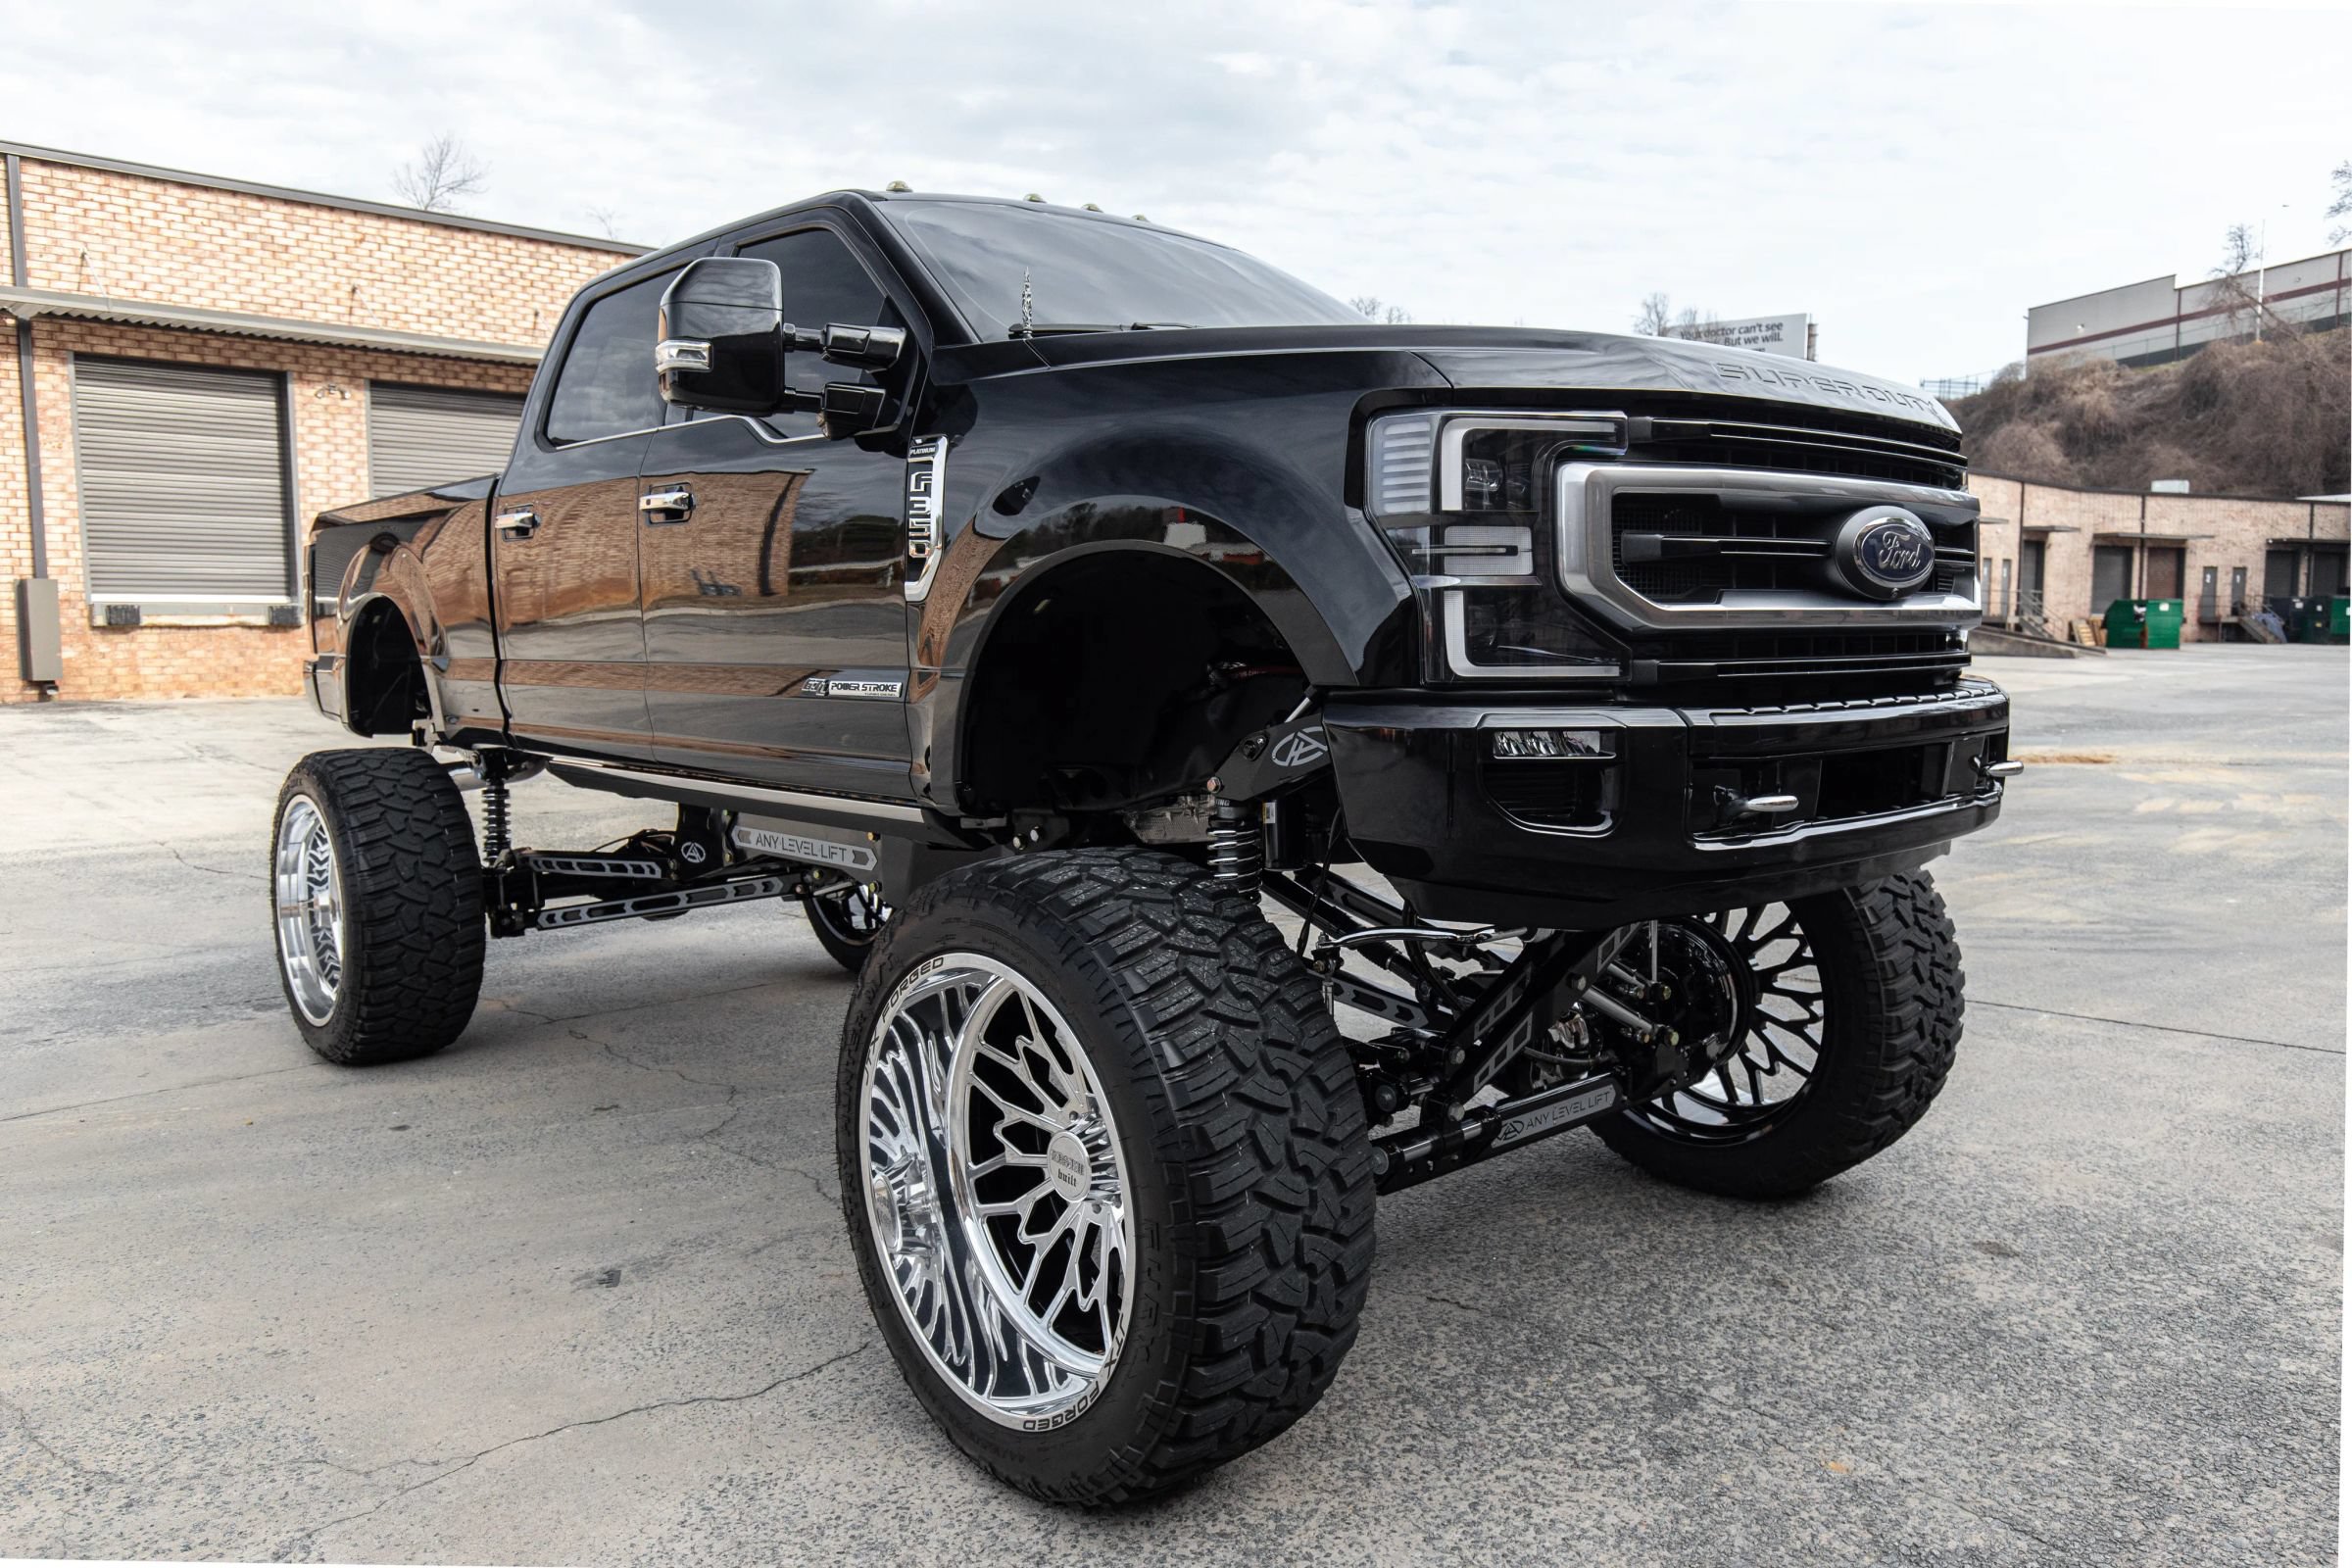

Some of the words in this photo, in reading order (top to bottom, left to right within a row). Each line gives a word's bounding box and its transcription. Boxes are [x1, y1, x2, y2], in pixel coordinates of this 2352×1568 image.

[1703, 326, 1736, 337] doctor
[1738, 322, 1763, 334] can't
[1765, 321, 1784, 331] see
[1724, 336, 1741, 347] But
[1743, 334, 1760, 344] we
[1761, 332, 1784, 343] will.
[1716, 363, 1866, 400] SUPER
[1861, 386, 1939, 416] DUTY
[909, 447, 936, 456] PLATINUM
[1879, 531, 1921, 569] Ford
[831, 682, 859, 691] POWER
[860, 683, 897, 692] STROKE
[755, 833, 779, 849] ANY
[781, 838, 818, 857] LEVEL
[820, 845, 848, 861] LIFT
[864, 1029, 880, 1086] JTX
[882, 956, 944, 1023] FORGED
[1526, 1111, 1550, 1130] ANY
[1551, 1101, 1586, 1120] LEVEL
[1588, 1091, 1610, 1108] LIFT
[1057, 1168, 1077, 1187] built
[1104, 1312, 1125, 1380] JTX
[1023, 1380, 1100, 1431] FORGED
